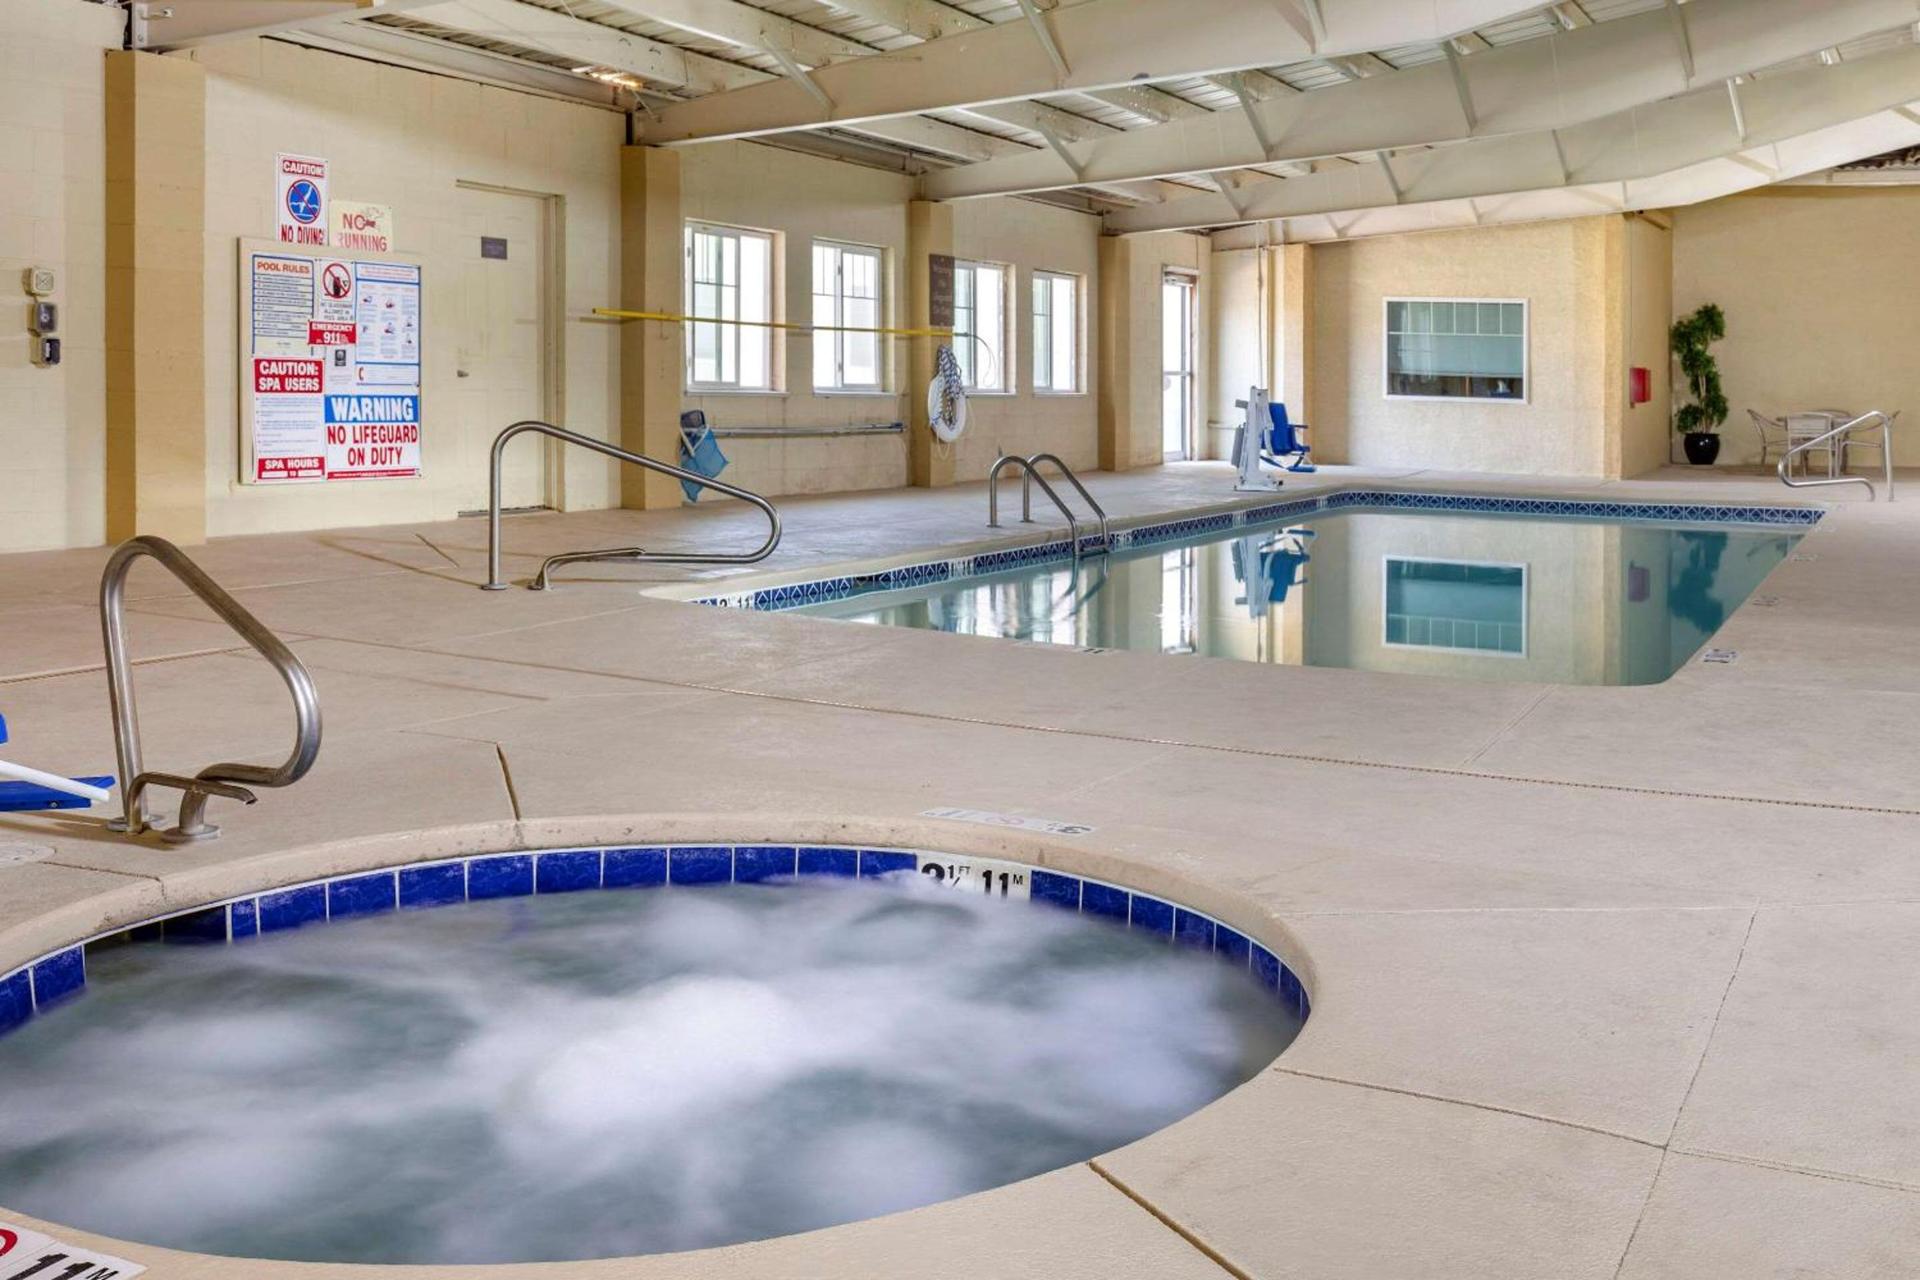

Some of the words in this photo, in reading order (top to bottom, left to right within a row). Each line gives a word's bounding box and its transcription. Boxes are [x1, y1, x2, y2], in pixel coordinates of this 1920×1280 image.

[281, 225, 294, 242] NO
[257, 261, 281, 272] POOL
[282, 263, 310, 274] RULES
[323, 332, 341, 344] 911
[259, 361, 319, 375] CAUTION:
[259, 378, 281, 391] SPA
[285, 378, 320, 391] USERS
[331, 397, 414, 421] WARNING
[327, 425, 346, 444] NO
[352, 425, 418, 443] LIFEGUARD
[347, 448, 365, 465] ON
[371, 447, 403, 465] DUTY
[264, 460, 285, 470] SPA
[287, 458, 319, 469] HOURS
